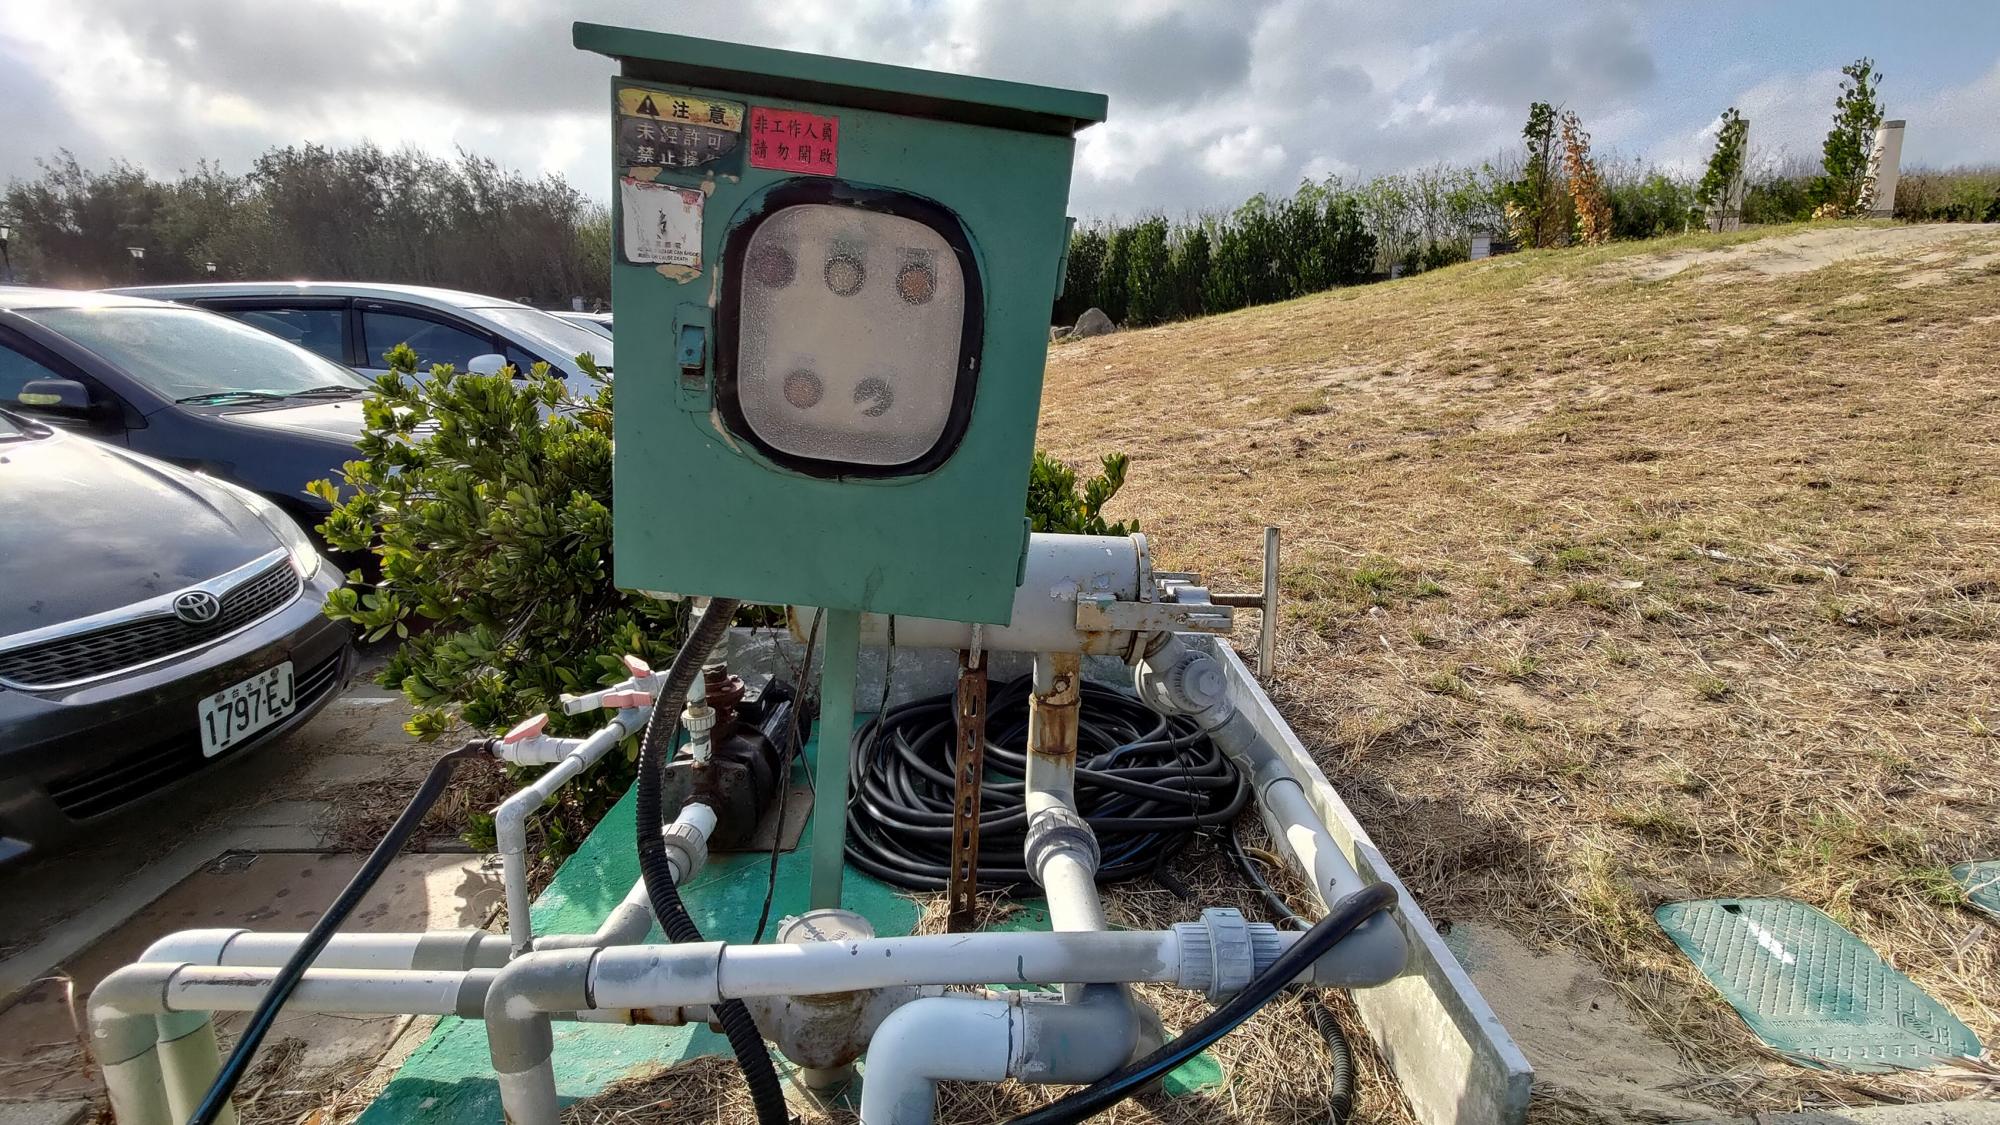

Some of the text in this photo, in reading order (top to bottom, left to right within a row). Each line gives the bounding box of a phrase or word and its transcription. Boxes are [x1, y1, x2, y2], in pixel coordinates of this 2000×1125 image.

[672, 100, 729, 126] 注意
[636, 123, 724, 150] 未經許可
[754, 114, 832, 143] 非工作人員
[753, 139, 833, 165] 請勿開啟
[231, 676, 266, 698] 台北市
